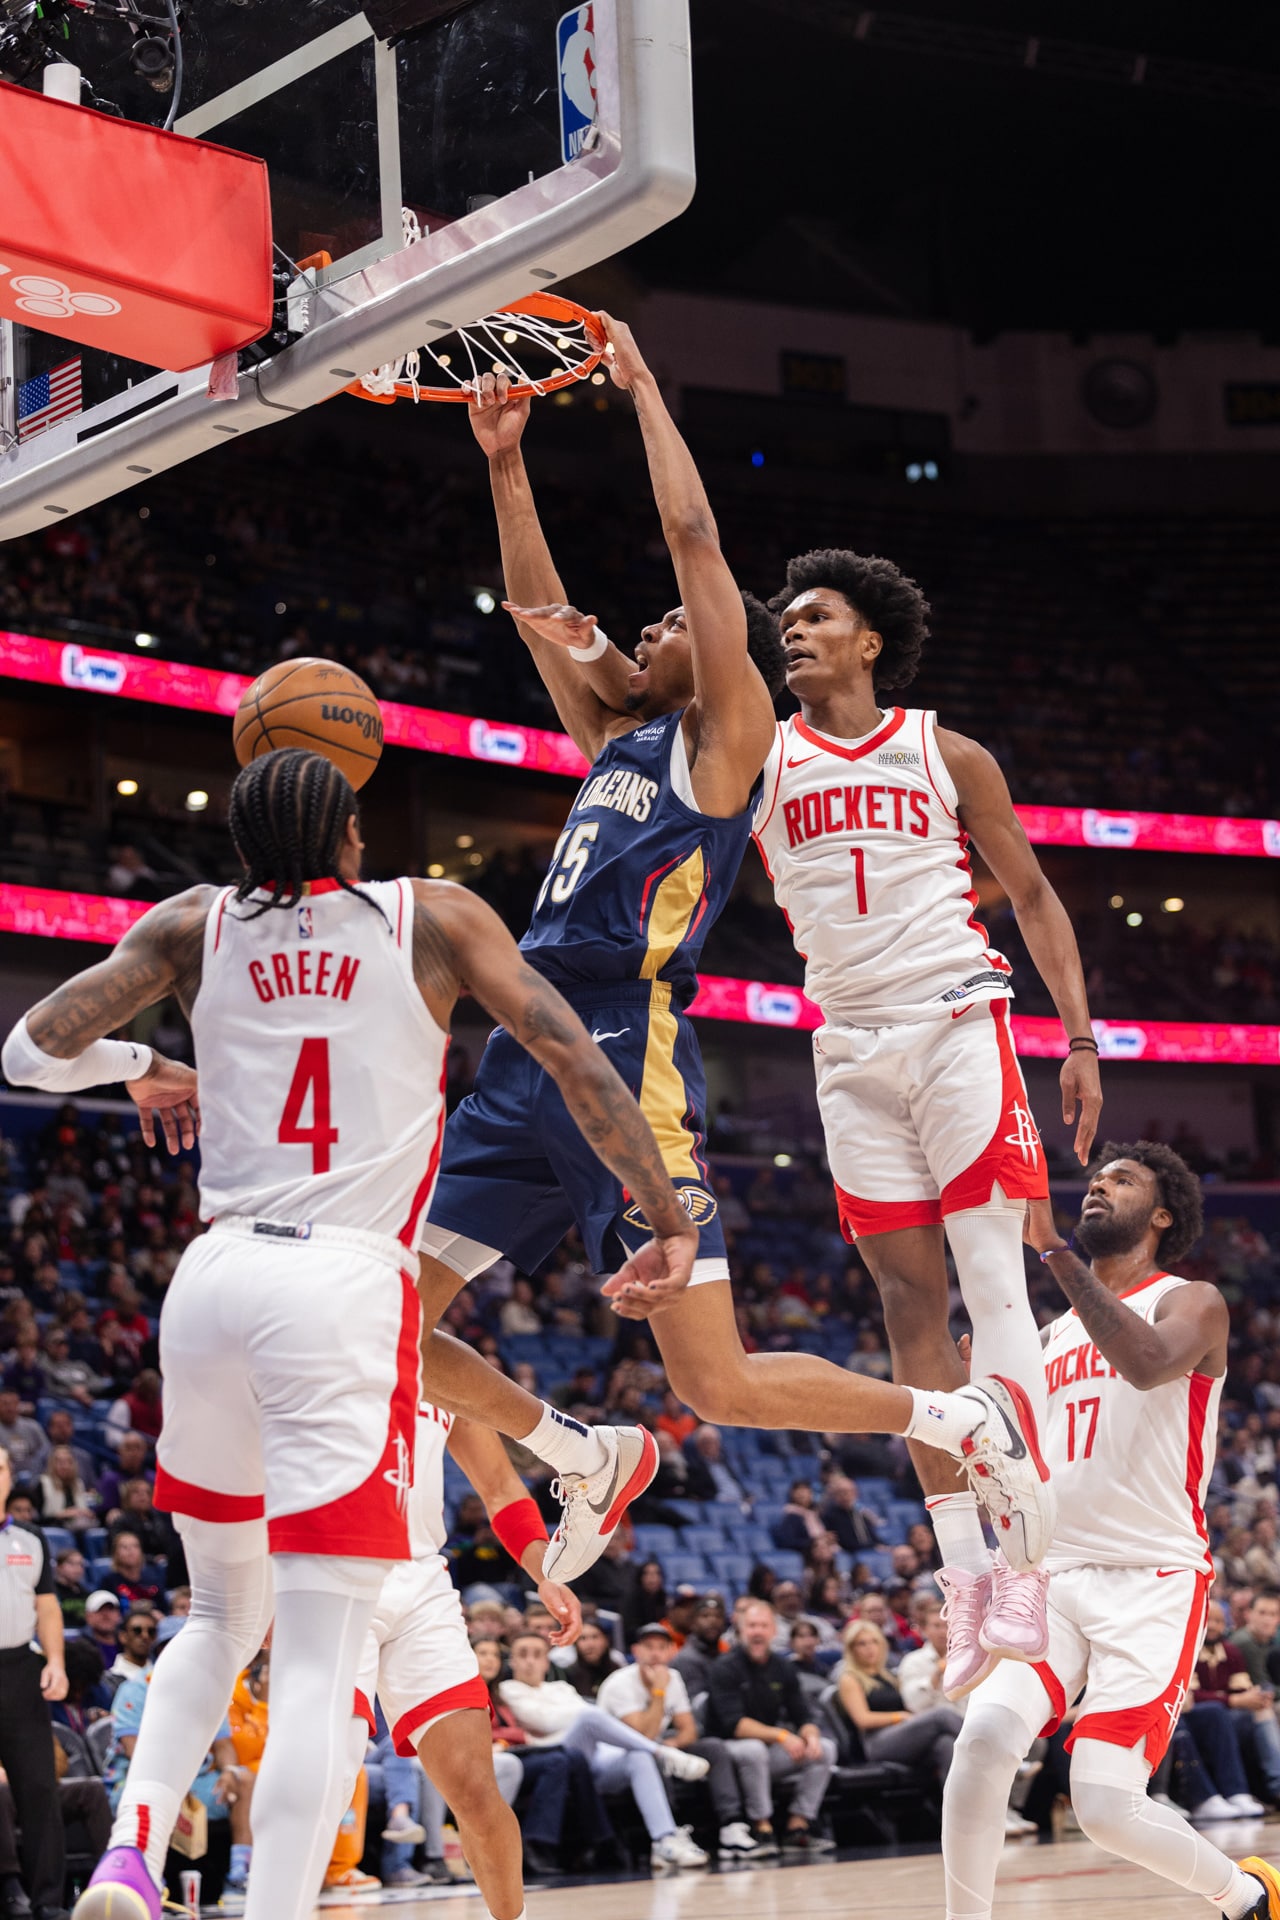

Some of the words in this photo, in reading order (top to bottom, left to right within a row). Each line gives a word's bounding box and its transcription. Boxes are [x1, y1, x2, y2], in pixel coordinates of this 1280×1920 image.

[878, 752, 920, 760] MEMORIAL
[577, 769, 659, 823] ORLEANS
[783, 785, 930, 849] ROCKETS
[850, 847, 868, 915] 1
[248, 950, 361, 1004] GREEN
[278, 1037, 339, 1176] 4
[1044, 1342, 1129, 1400] OCKE
[1065, 1396, 1101, 1463] 17
